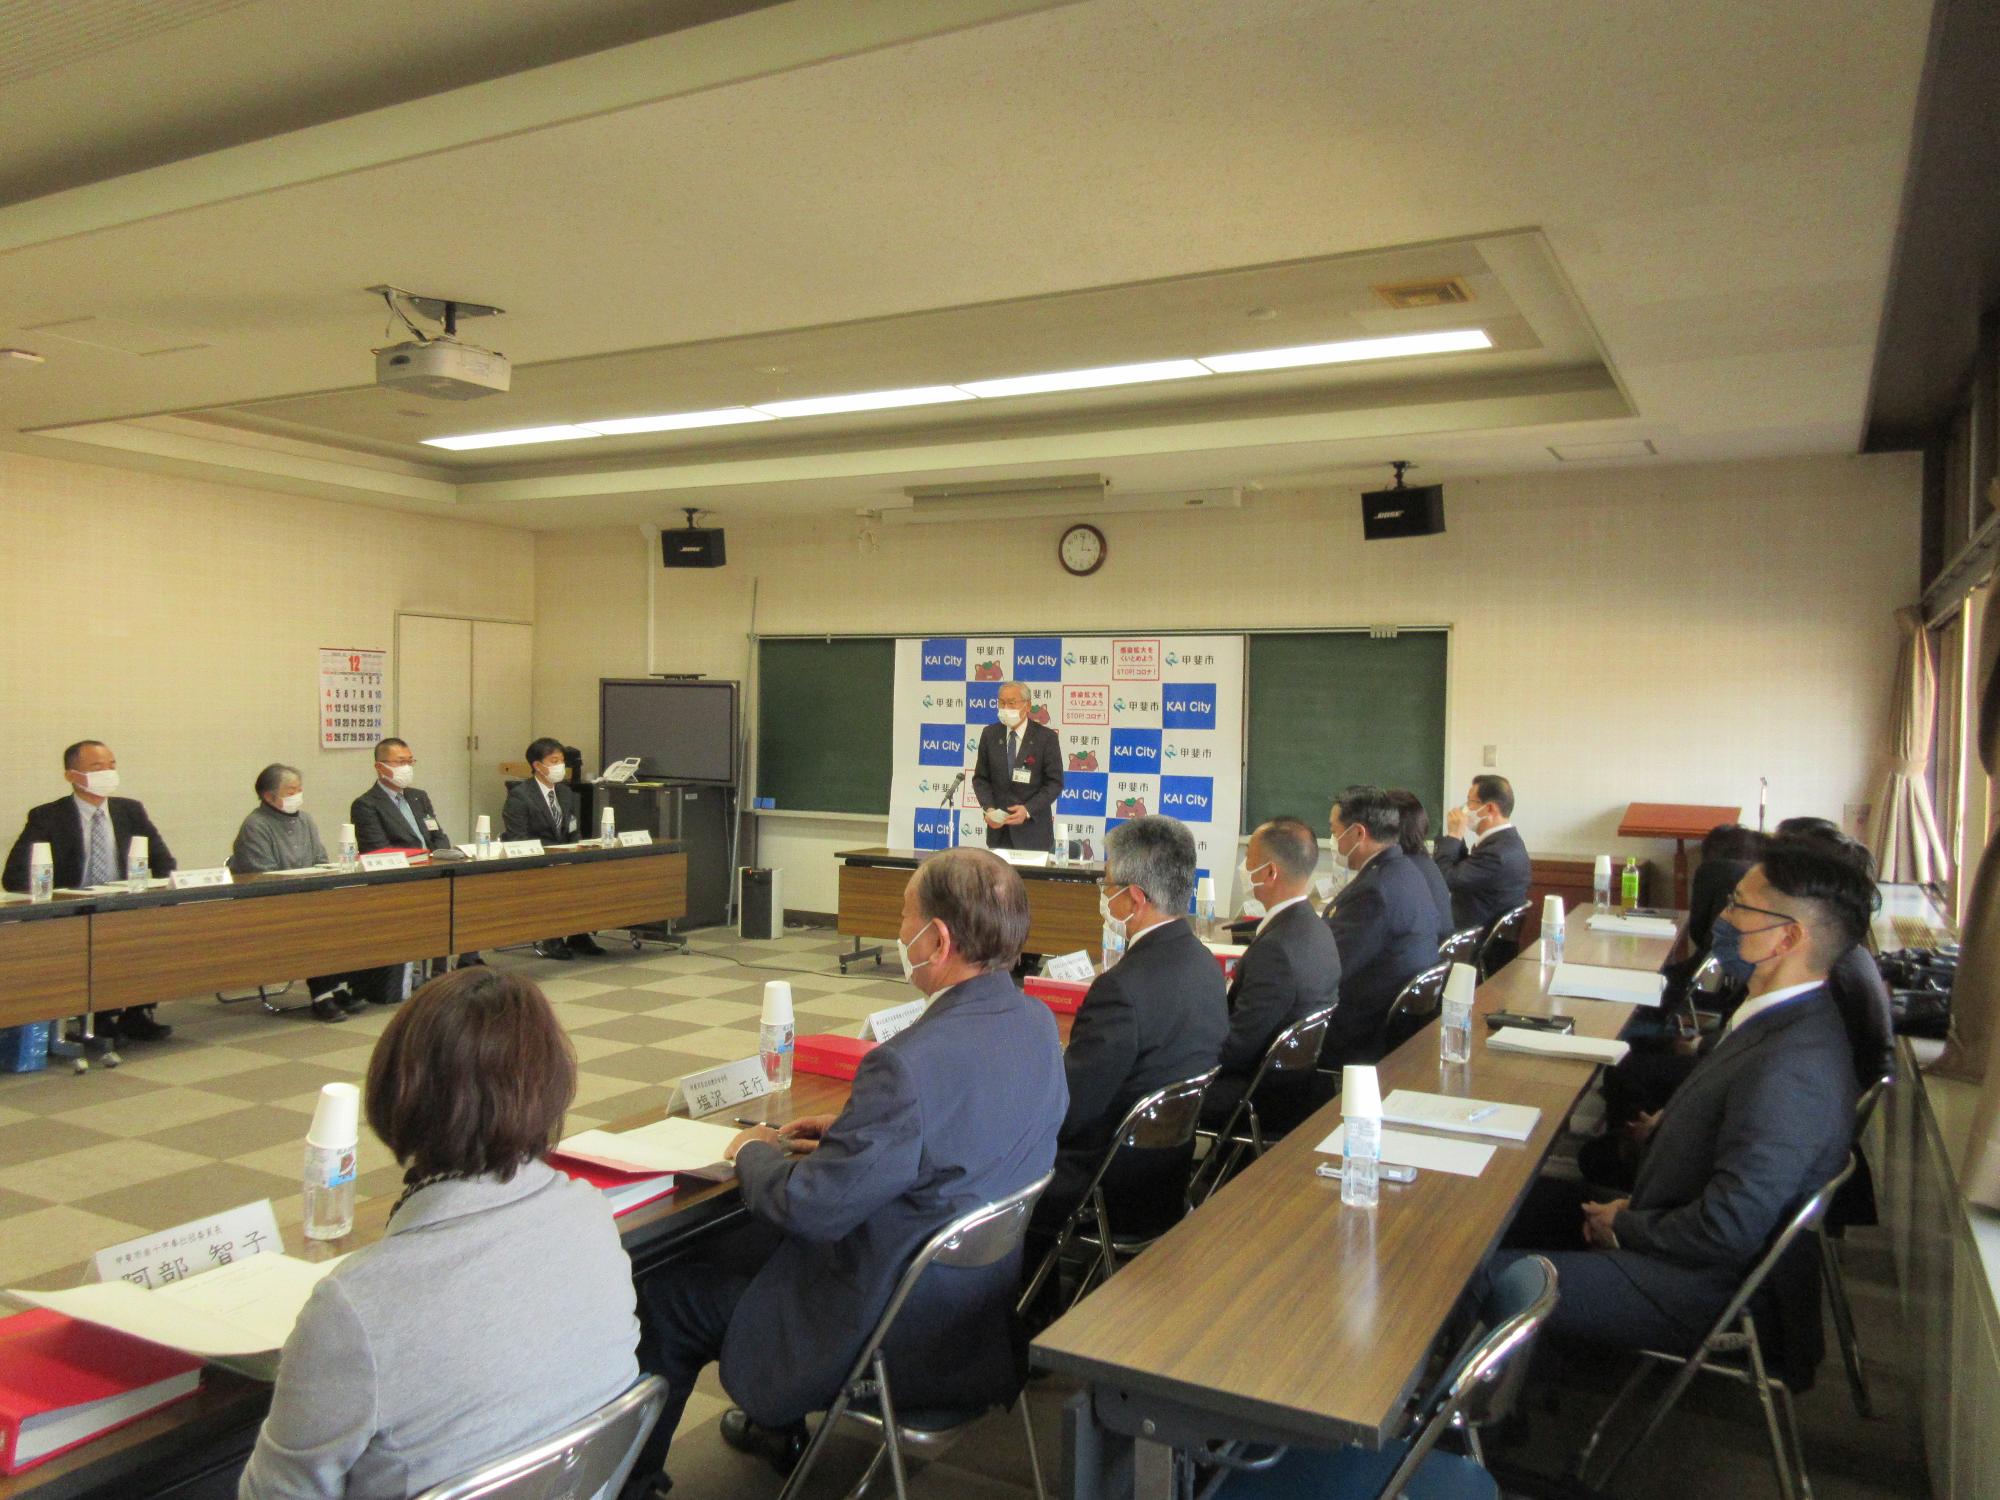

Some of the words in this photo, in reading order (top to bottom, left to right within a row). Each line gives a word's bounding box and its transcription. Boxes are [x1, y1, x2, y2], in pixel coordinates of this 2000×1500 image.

[976, 646, 1004, 656] 甲斐市
[348, 655, 360, 672] 12
[925, 656, 940, 665] KAI
[944, 656, 962, 667] City
[1018, 656, 1034, 665] KAI
[1037, 656, 1057, 667] City
[1079, 655, 1109, 665] 甲斐市
[1182, 655, 1214, 665] 甲斐市
[336, 689, 340, 698] 5
[353, 689, 356, 698] 7
[1033, 690, 1052, 699] 斐市
[936, 698, 963, 707] 甲斐市
[970, 699, 986, 708] KAI
[1129, 701, 1159, 711] 甲斐市
[1166, 702, 1186, 712] KAI
[1189, 701, 1211, 714] City
[326, 704, 332, 712] 11
[351, 704, 357, 712] 14
[359, 704, 365, 712] 15
[375, 704, 381, 712] 17
[342, 718, 349, 727] 20
[351, 718, 357, 727] 21
[359, 718, 365, 727] 22
[367, 718, 373, 727] 23
[343, 732, 349, 741] 27
[1070, 736, 1100, 745] 甲斐市
[923, 741, 939, 750] KAI
[942, 741, 960, 752] City
[1114, 746, 1132, 756] KAI
[1135, 746, 1156, 759] City
[1180, 750, 1212, 759] 甲斐市
[1118, 782, 1149, 792] 甲斐市
[1061, 789, 1078, 798] KAI
[1082, 790, 1103, 801] City
[1163, 795, 1182, 805] KAI
[1186, 795, 1208, 808] City
[917, 824, 933, 834] KAI
[739, 1076, 764, 1098] 正行
[208, 1229, 268, 1266] 智子
